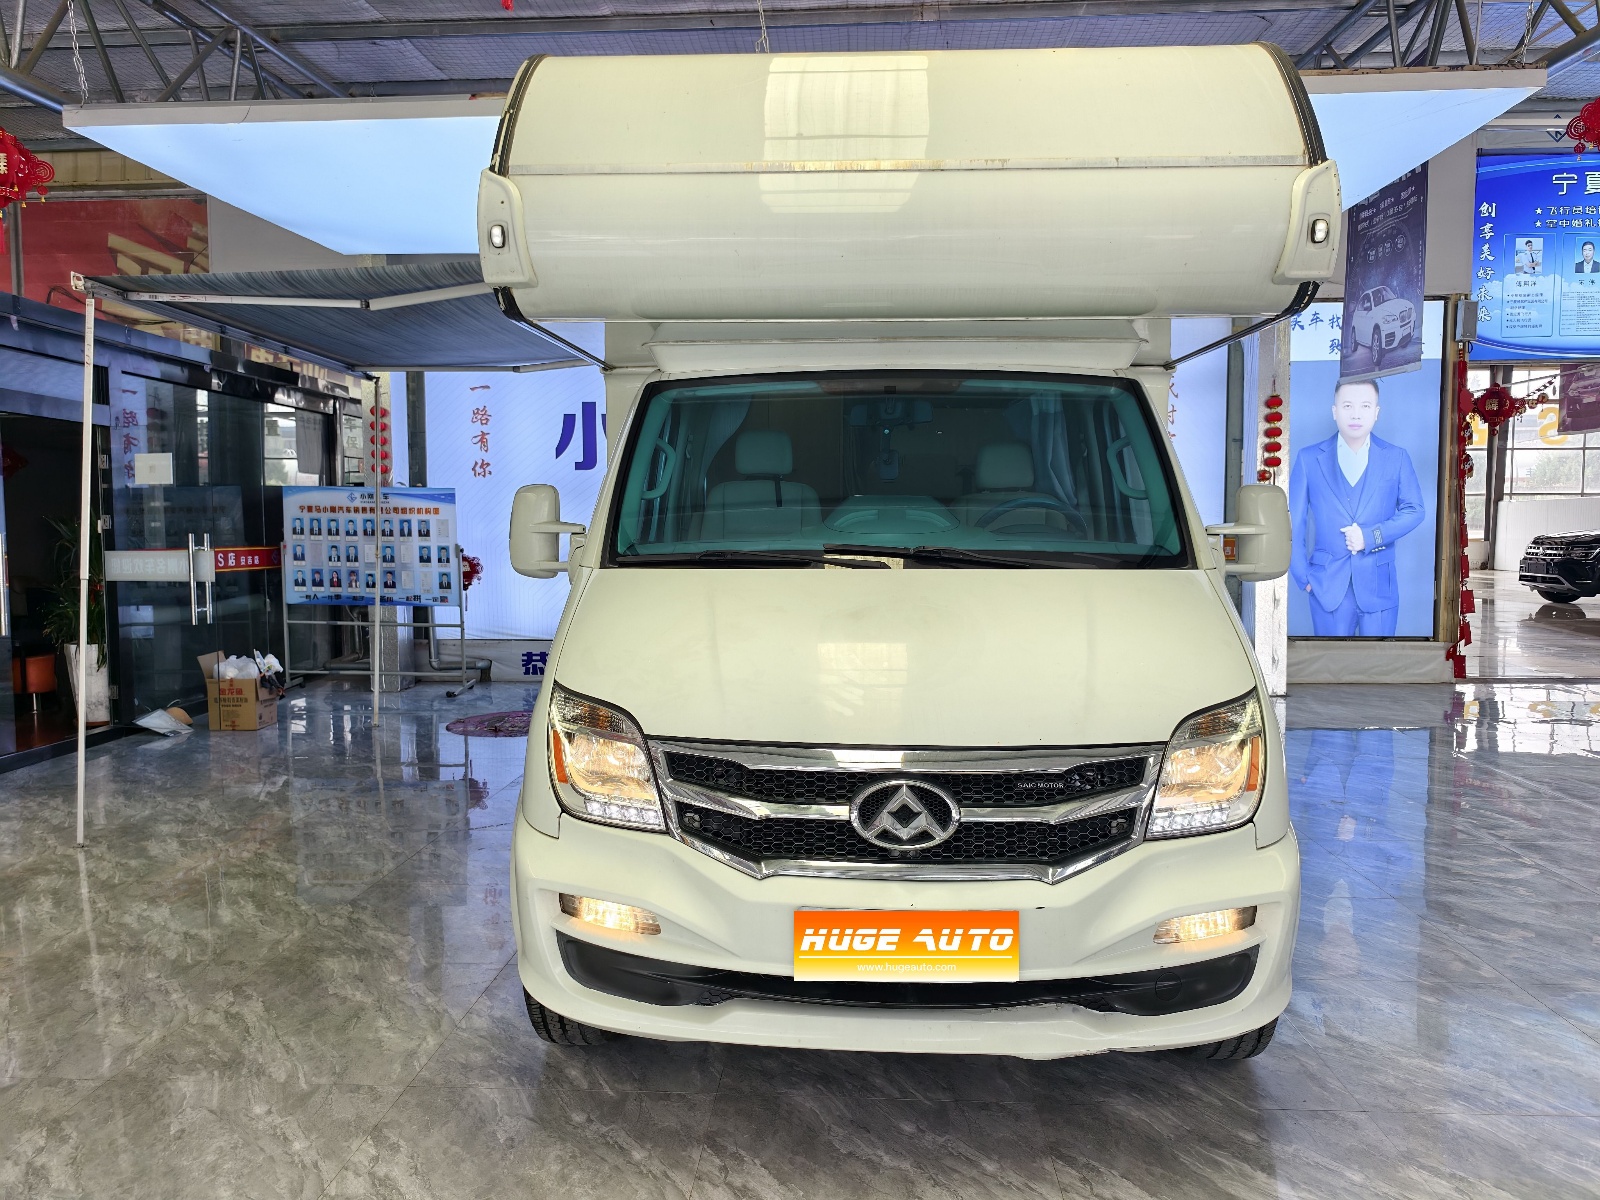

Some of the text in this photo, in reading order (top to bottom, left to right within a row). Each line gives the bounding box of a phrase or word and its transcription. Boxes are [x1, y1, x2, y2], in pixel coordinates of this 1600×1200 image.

[1545, 219, 1600, 228] 空中婚礼
[1546, 206, 1600, 216] 飞行员培
[1476, 201, 1497, 322] 创享美好未来
[469, 384, 493, 479] 一路有你
[555, 401, 608, 471] 小
